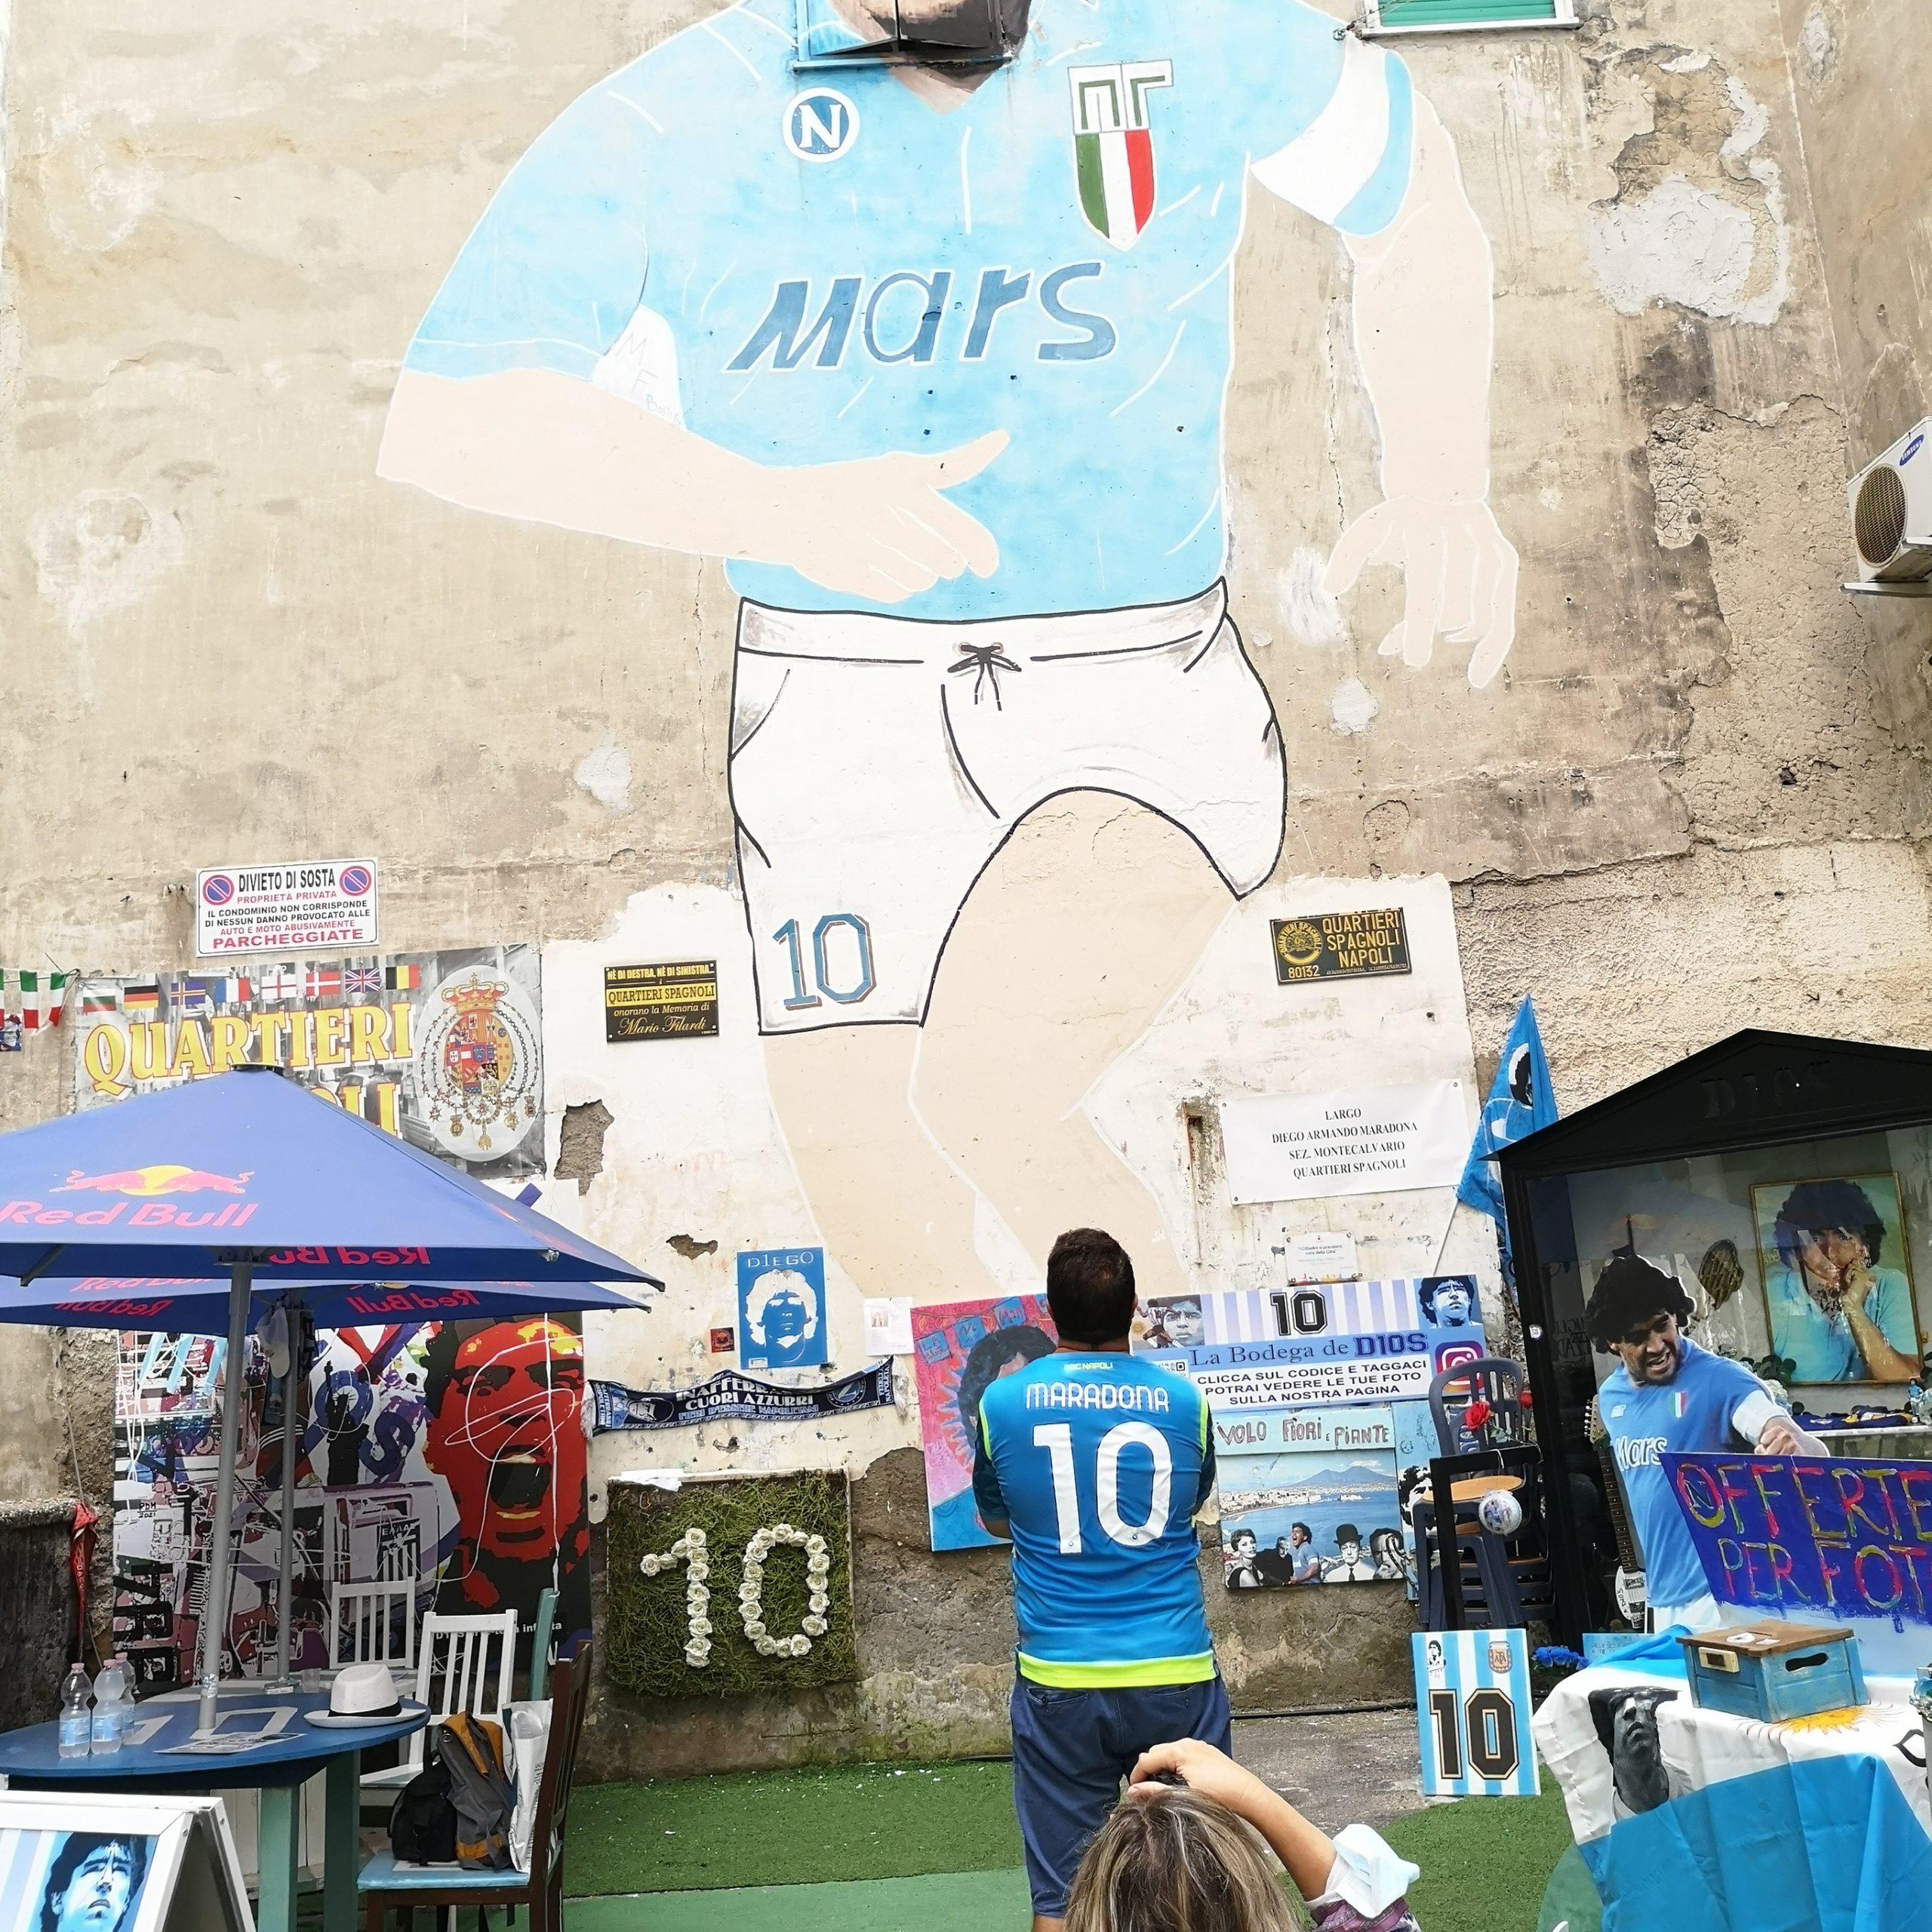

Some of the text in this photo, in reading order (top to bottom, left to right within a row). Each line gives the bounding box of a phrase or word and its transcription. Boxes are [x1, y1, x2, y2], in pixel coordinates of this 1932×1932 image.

[797, 104, 842, 150] N
[238, 869, 335, 893] DIVIETO DI SOSTA
[296, 891, 337, 900] PRIVATA
[217, 918, 253, 926] NESSUN
[257, 915, 288, 924] DANNO
[291, 912, 345, 921] PROVOCATO
[219, 906, 277, 917] CONDOMINIO
[303, 900, 368, 911] CORRISPONDE
[256, 924, 281, 933] MOTO
[285, 920, 355, 931] ABUSIVAMENTE
[1322, 912, 1399, 934] QUARTIERI
[213, 929, 364, 949] PARCHEGGIATE
[1278, 922, 1321, 953] QUARTIERI SPAGNOLI
[1327, 929, 1400, 950] SPAGNOLI
[773, 913, 877, 1011] 10
[1339, 948, 1393, 968] NAPOLI
[618, 970, 626, 979] DI
[627, 968, 656, 979] DESTRA,
[667, 967, 675, 976] DI
[1288, 965, 1320, 978] 80132
[608, 986, 715, 1004] QUARTIERI SPAGNOLI
[614, 1008, 649, 1017] onorano
[662, 1004, 699, 1014] Memoria
[701, 1002, 709, 1011] di
[618, 1015, 706, 1035] Mario Filardi
[85, 1001, 415, 1096] QUARTIERI
[1325, 1108, 1361, 1120] LARGO
[1272, 1121, 1418, 1143] DIEGO ARMANDO MARADONA
[1289, 1141, 1405, 1160] SEZ. MONTECALVARIO
[1294, 1158, 1406, 1180] QUARTIERI SPAGNOLI
[0, 1201, 259, 1226] Red Bull
[1270, 1290, 1329, 1337] 10
[1189, 1349, 1220, 1366] La
[1227, 1343, 1314, 1364] Bodega
[1323, 1340, 1349, 1356] de
[1082, 1362, 1113, 1371] NAPOLI
[1198, 1360, 1426, 1385] CLICCA SUL CODICE E TAGGACI
[1205, 1372, 1421, 1395] POTRAI VEDERE LE TUE FOTO
[685, 1392, 814, 1411] CUORI AZZURRI
[1026, 1382, 1170, 1413] MARADONA
[1229, 1385, 1400, 1405] SULLA NOSTRA PAGINA
[678, 1408, 705, 1420] FIERI
[758, 1404, 819, 1415] NAPOLETANI
[1615, 1435, 1667, 1472] Mars
[1033, 1420, 1172, 1553] 10
[1676, 1463, 1932, 1542] OFFERTE
[1718, 1538, 1932, 1614] PER FOT
[640, 1523, 830, 1669] 10
[1429, 1688, 1520, 1780] 10
